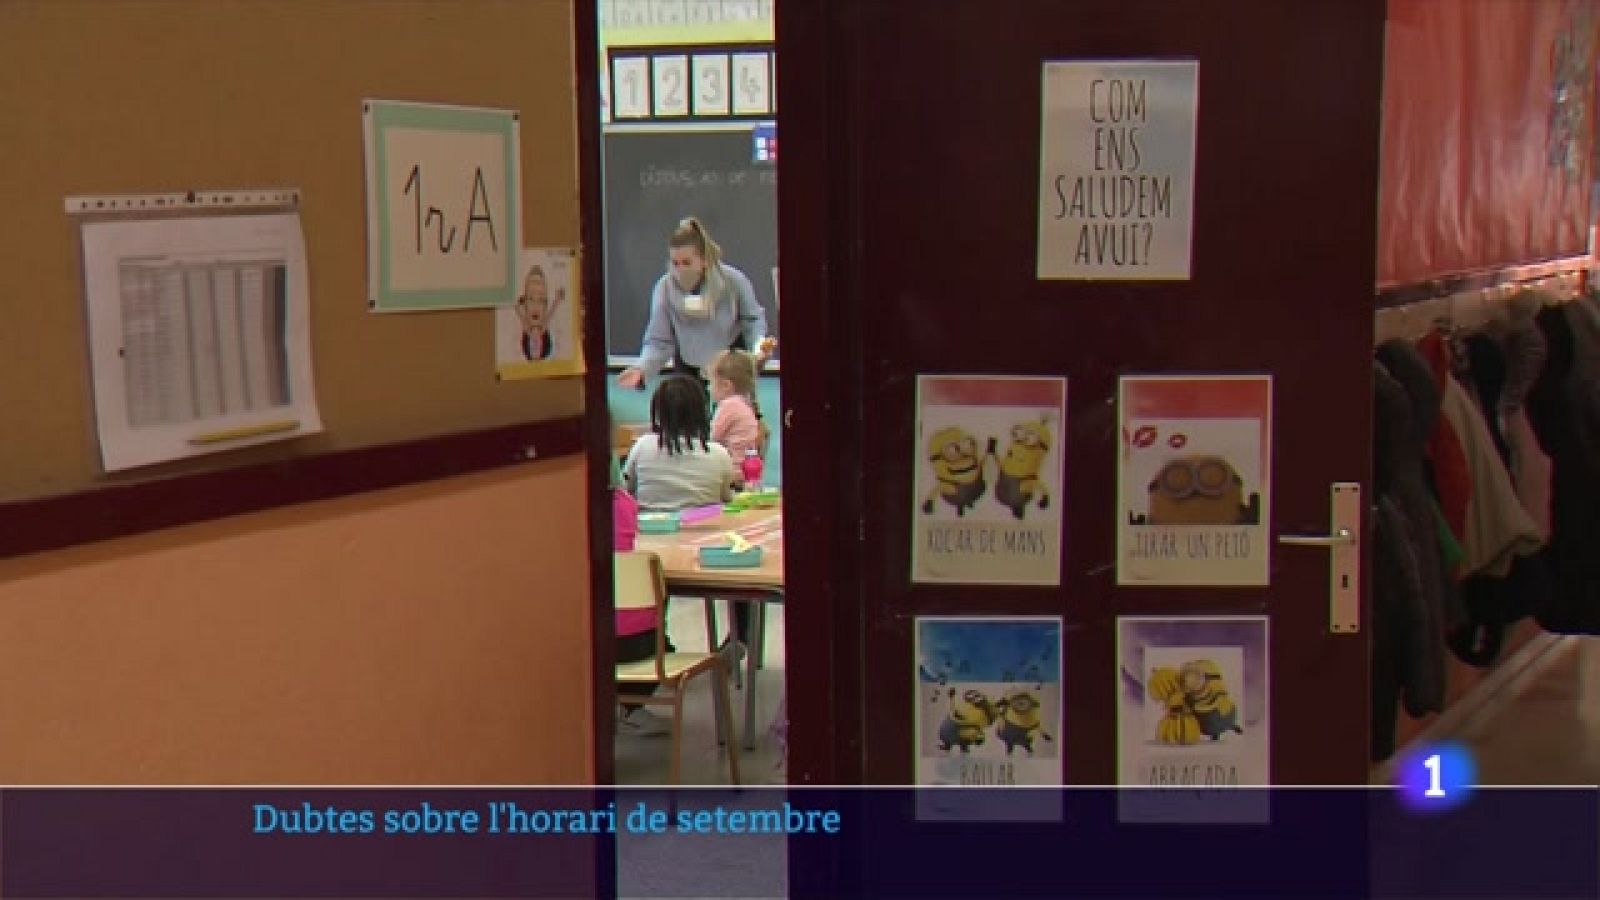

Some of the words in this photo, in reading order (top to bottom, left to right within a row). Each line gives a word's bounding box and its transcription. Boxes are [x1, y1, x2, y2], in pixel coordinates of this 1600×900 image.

[622, 69, 639, 106] 1
[662, 66, 683, 106] 2
[702, 66, 721, 103] 3
[740, 66, 761, 103] 4
[1089, 79, 1147, 123] COM
[1094, 127, 1141, 171] ENS
[1054, 174, 1171, 219] SALUDEM
[1074, 224, 1154, 266] AVUI?
[979, 528, 996, 555] DE
[1004, 528, 1047, 556] MANS
[1187, 531, 1209, 558] UN
